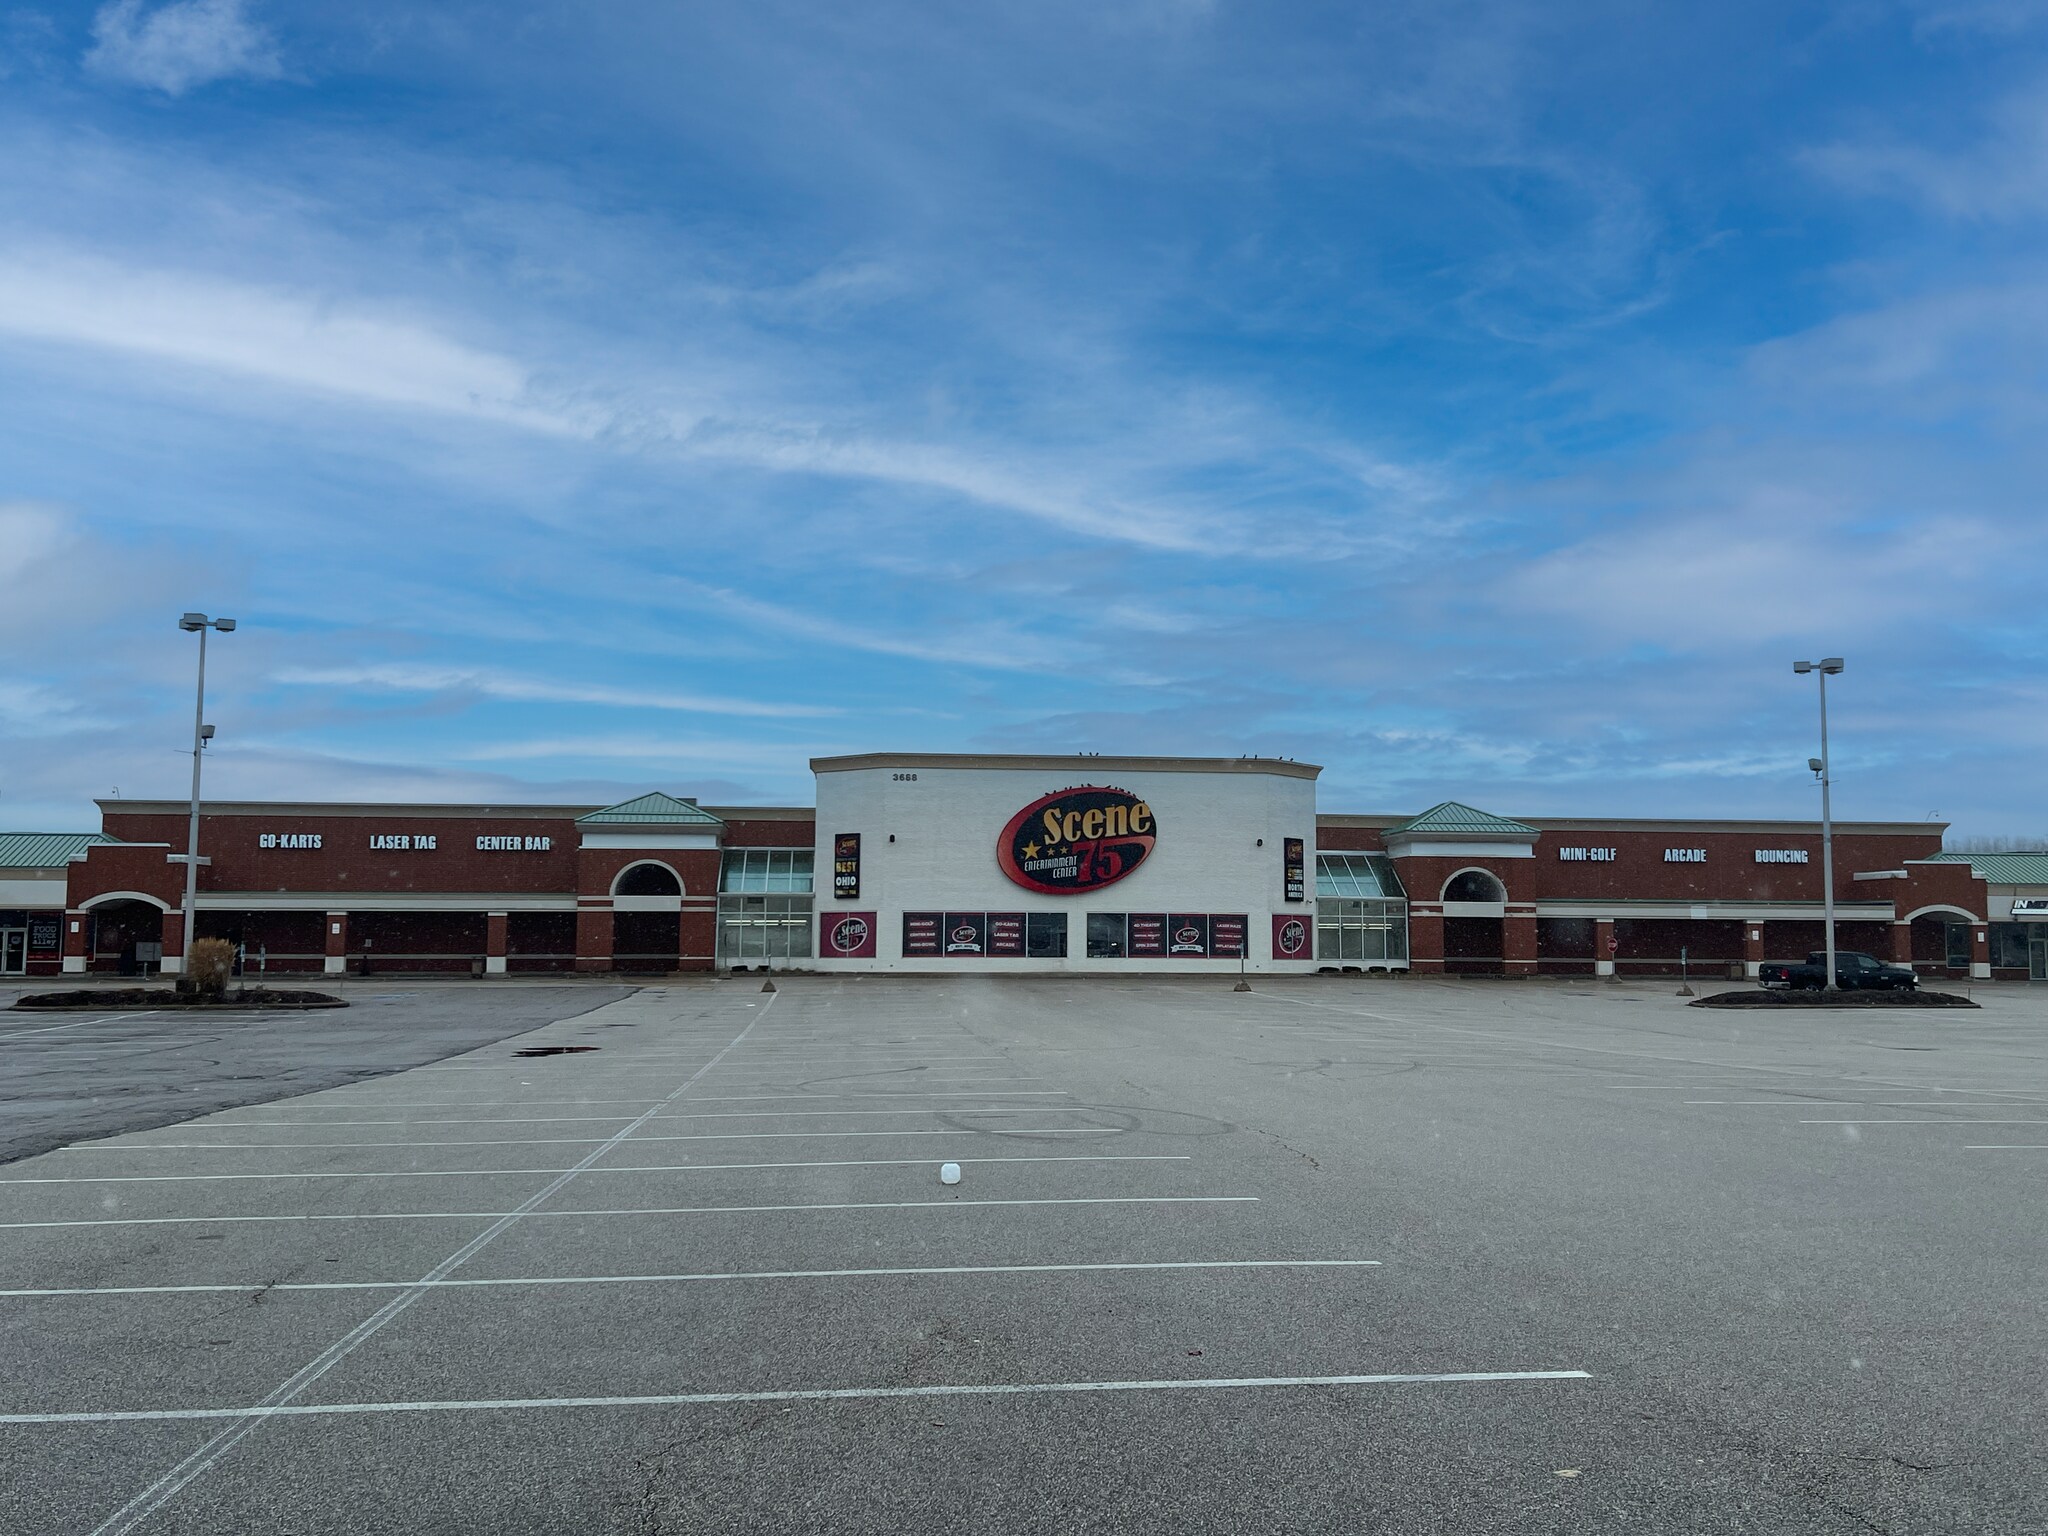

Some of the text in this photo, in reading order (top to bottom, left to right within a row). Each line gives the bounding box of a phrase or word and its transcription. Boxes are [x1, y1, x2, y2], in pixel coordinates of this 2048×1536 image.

[892, 773, 917, 781] 3688
[1043, 803, 1151, 846] Scene
[259, 834, 322, 848] GO-KARTS
[370, 835, 437, 849] LASER TAG
[476, 836, 550, 850] CENTER BAR
[1559, 847, 1617, 861] MINI-GOLF
[1664, 849, 1707, 863] ARCADE
[1755, 850, 1809, 864] BOUNCING
[836, 862, 857, 872] BEST
[1024, 856, 1078, 871] ENTERTAINMENT
[1071, 841, 1122, 882] 75
[1052, 866, 1078, 879] CENTER
[836, 876, 857, 886] OHIO
